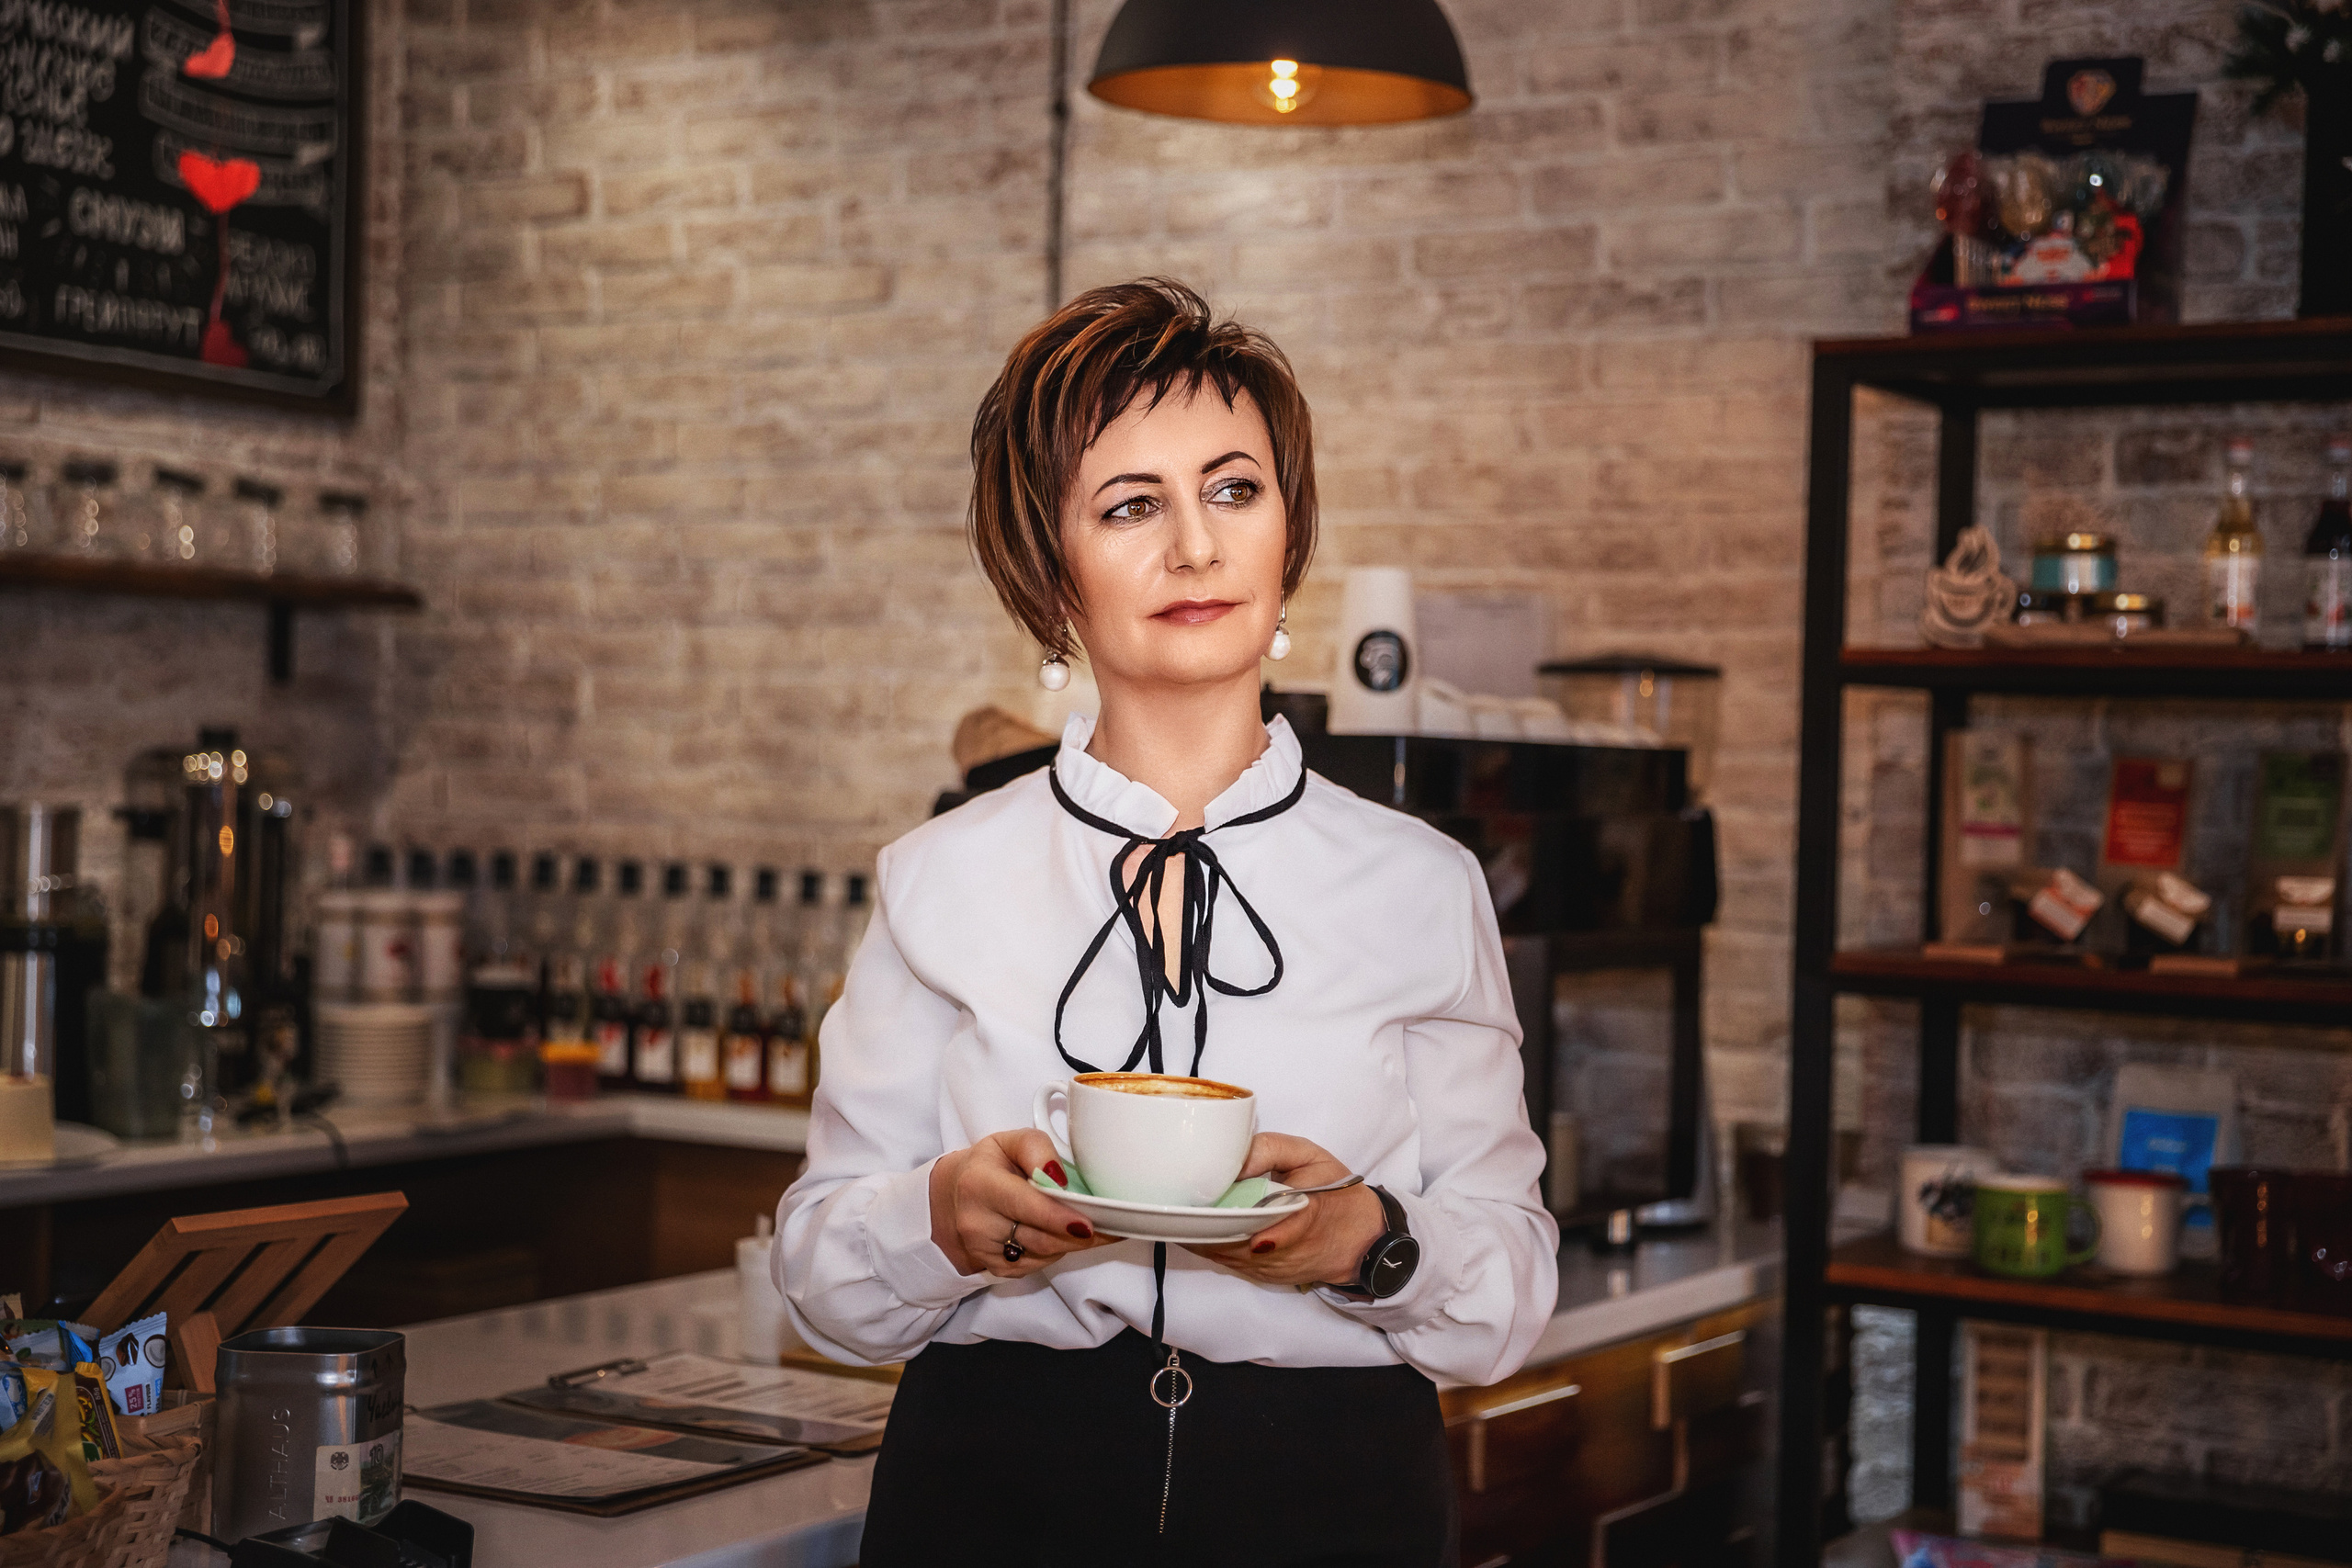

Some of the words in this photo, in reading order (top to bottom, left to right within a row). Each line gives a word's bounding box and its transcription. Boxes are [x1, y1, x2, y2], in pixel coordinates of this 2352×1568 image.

[128, 1388, 138, 1409] 25%
[268, 1408, 291, 1520] ALTHAUS
[369, 1444, 384, 1466] 10
